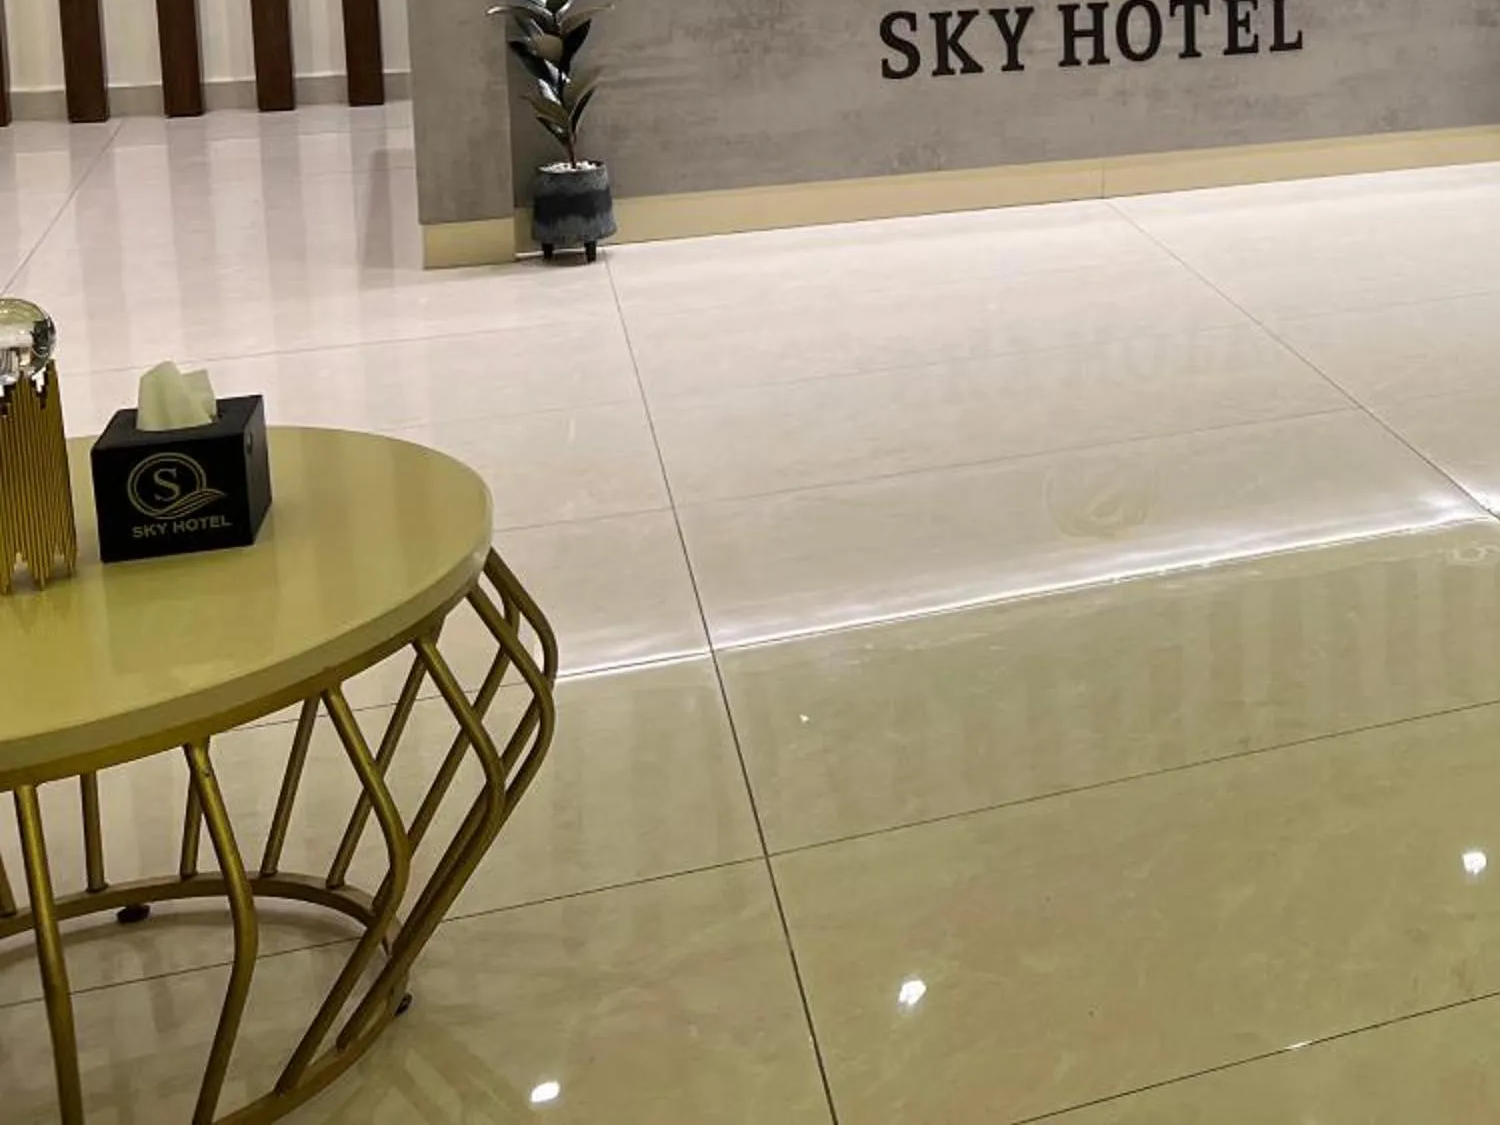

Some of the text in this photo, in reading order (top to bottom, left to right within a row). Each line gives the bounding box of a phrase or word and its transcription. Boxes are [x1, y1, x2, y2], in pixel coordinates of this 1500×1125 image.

[879, 6, 1035, 80] SKY
[153, 468, 180, 502] S
[131, 515, 233, 539] SKY HOTEL
